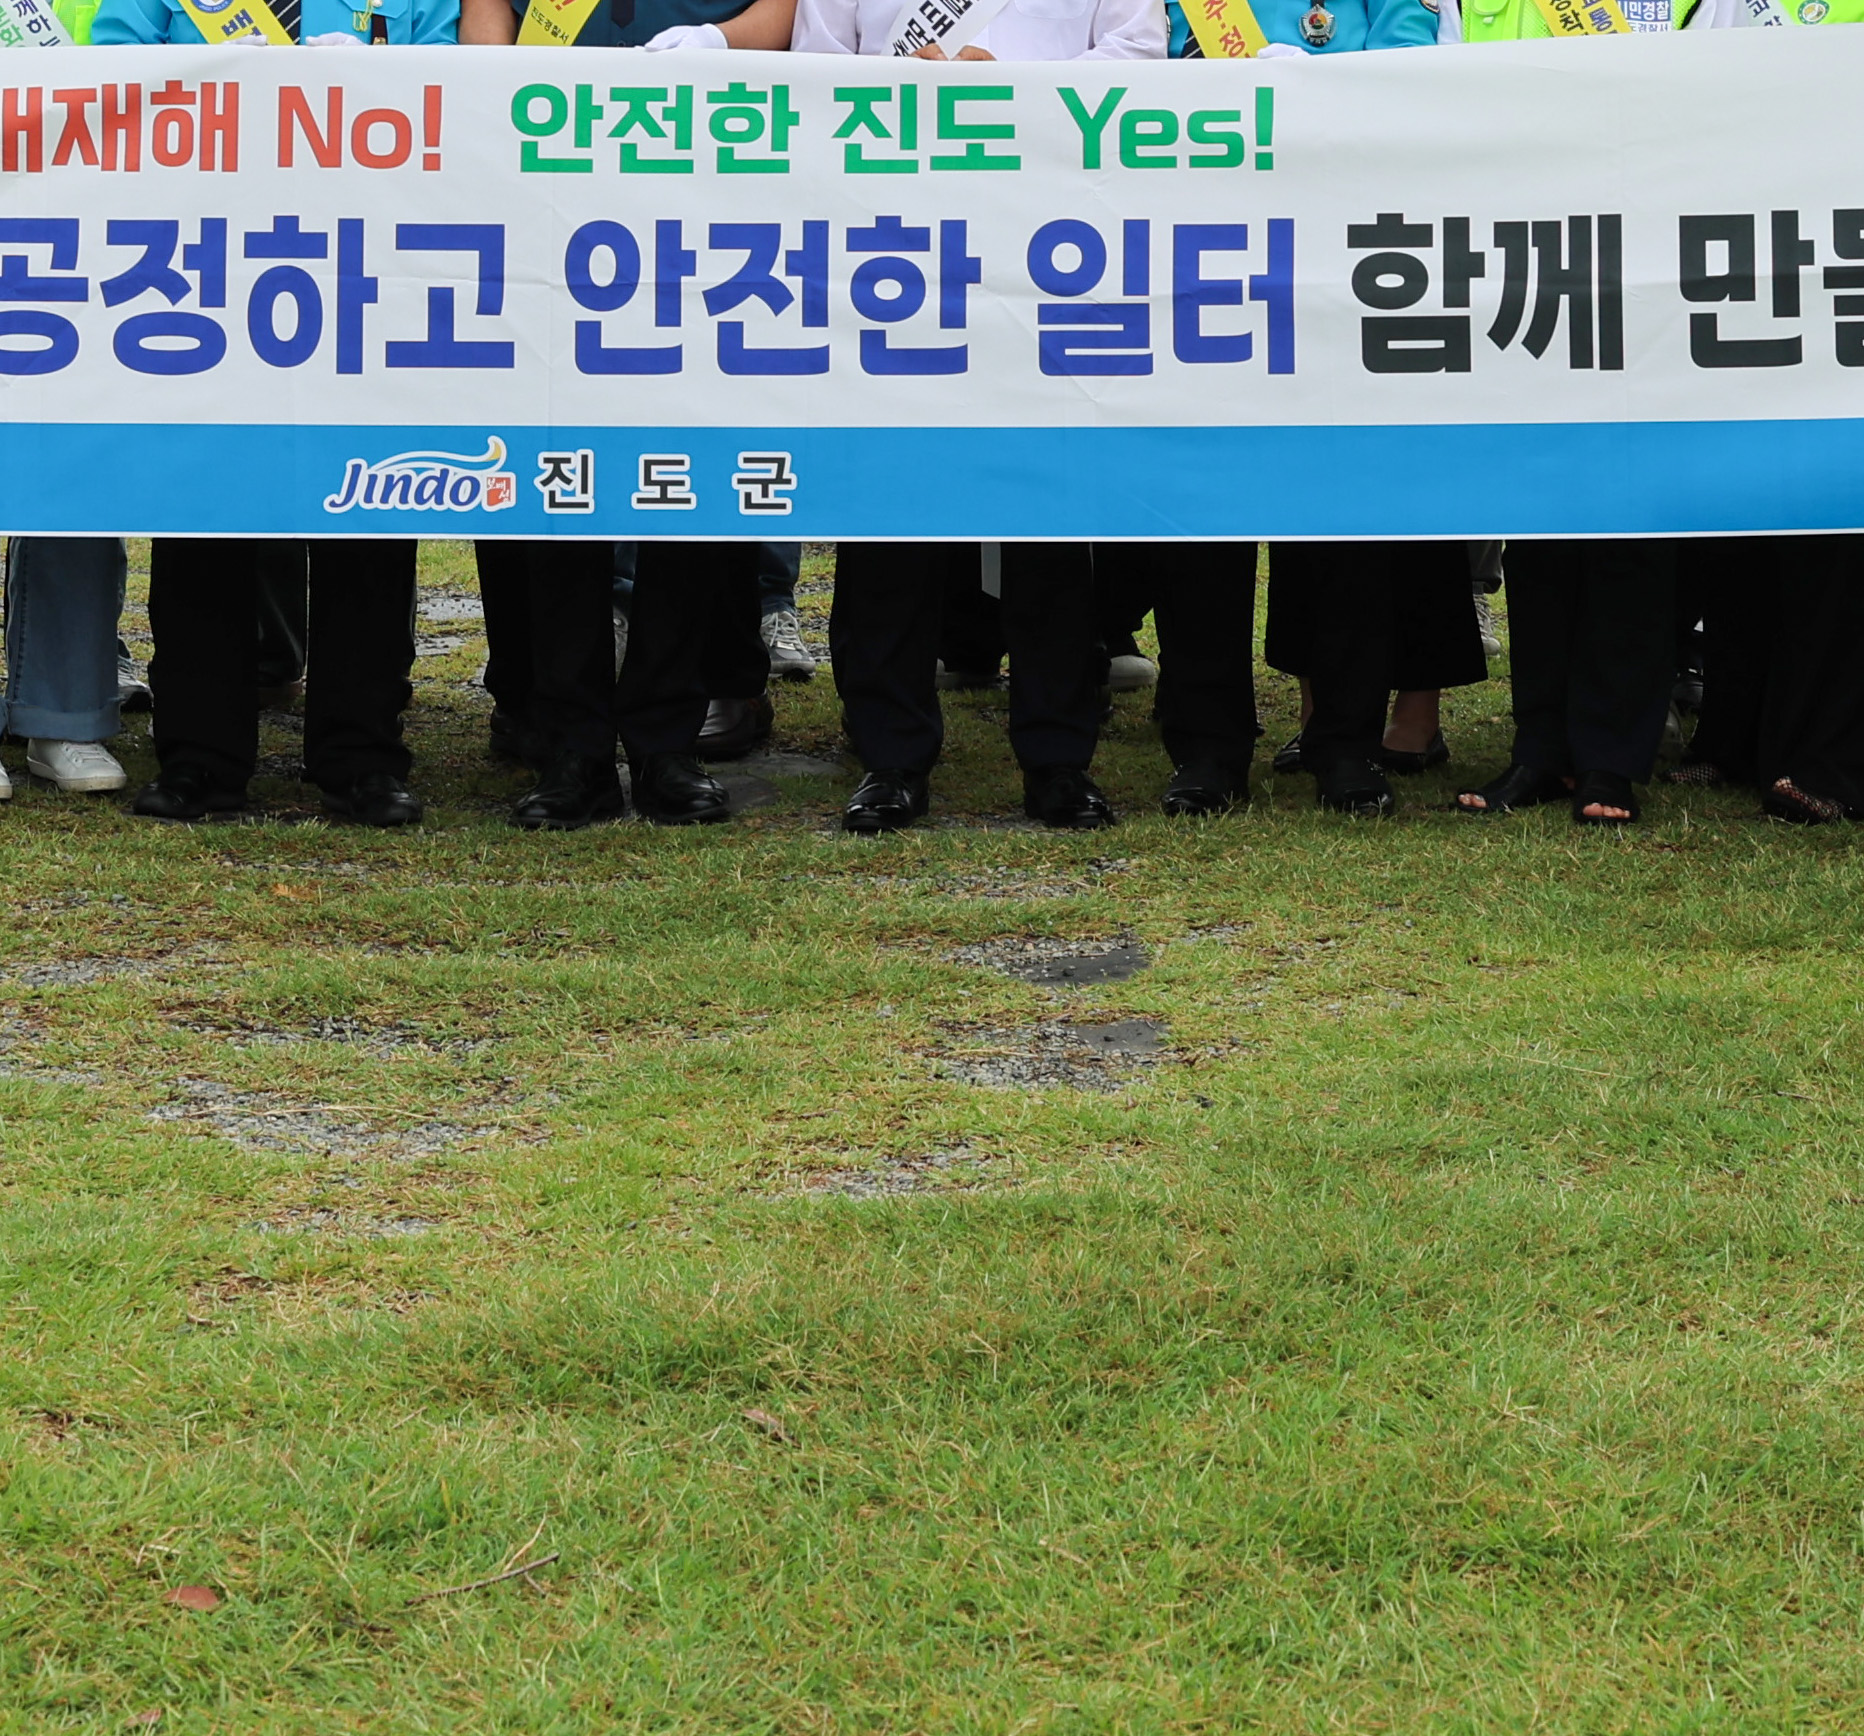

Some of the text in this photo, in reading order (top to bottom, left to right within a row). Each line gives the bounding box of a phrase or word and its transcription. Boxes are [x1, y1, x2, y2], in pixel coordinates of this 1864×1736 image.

[531, 6, 569, 44] 진도경찰서
[280, 86, 442, 171] No!
[512, 82, 799, 174] 안전한
[833, 84, 1022, 174] 진도
[1058, 87, 1274, 171] Yes!
[565, 215, 981, 376] 안전한
[1028, 218, 1295, 376] 일터
[1347, 213, 1624, 374] 함께
[329, 463, 481, 508] Jindo
